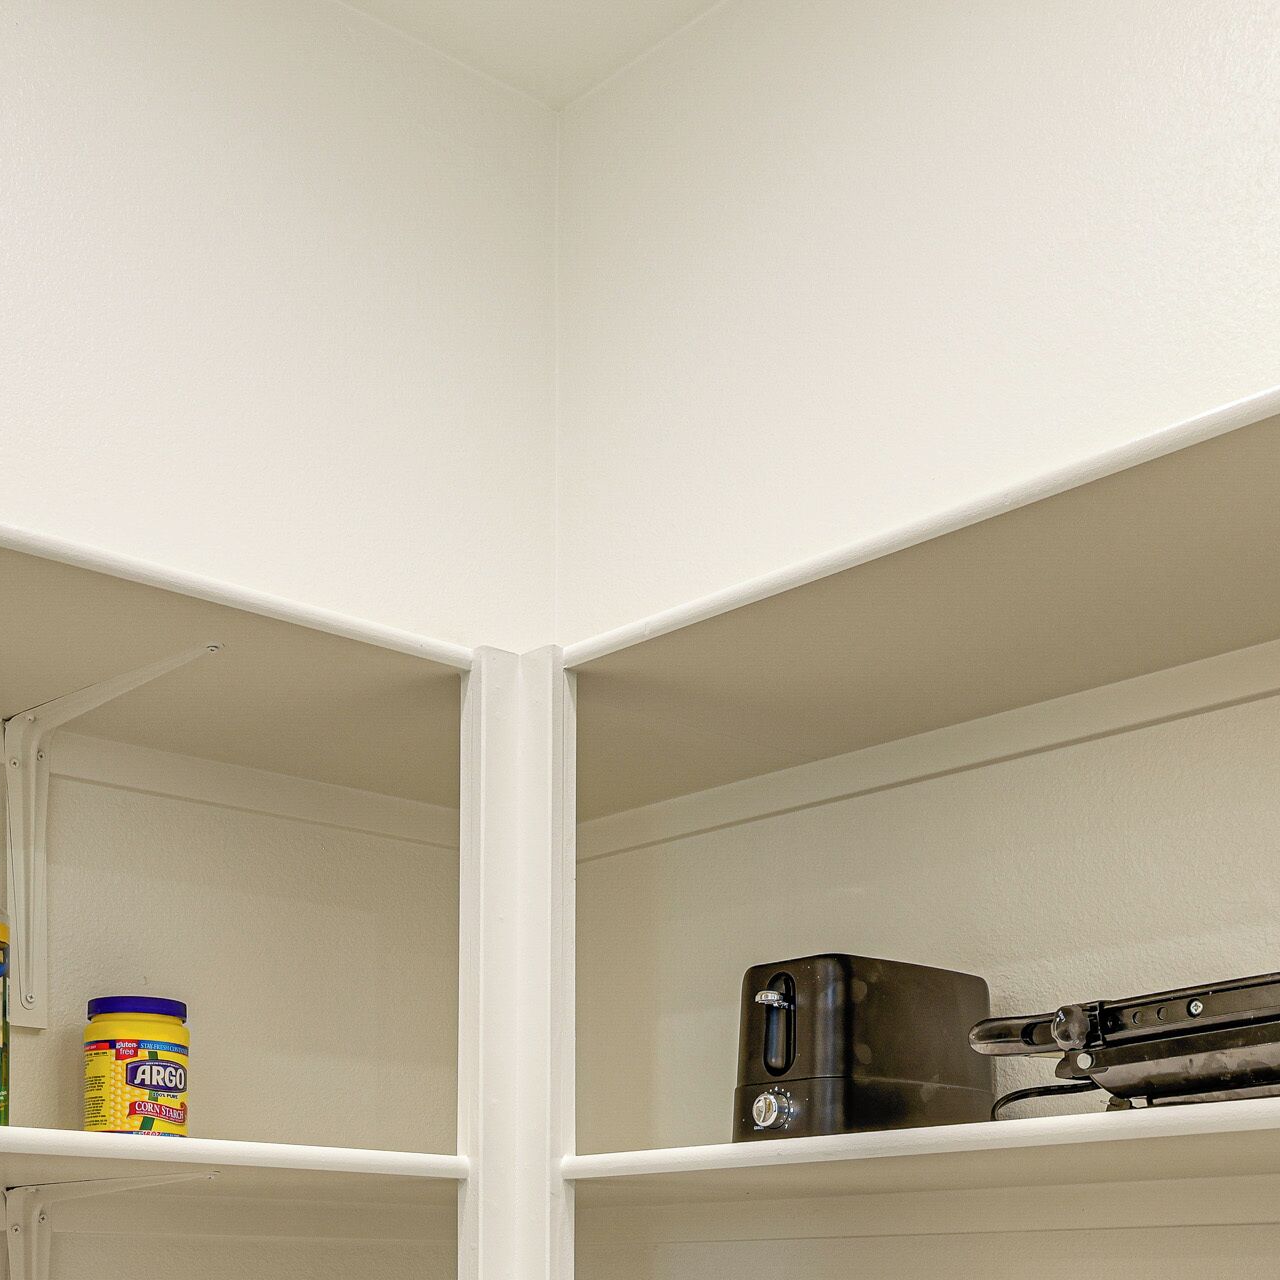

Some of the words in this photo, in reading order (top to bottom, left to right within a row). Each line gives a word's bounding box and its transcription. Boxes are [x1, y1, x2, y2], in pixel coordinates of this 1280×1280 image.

[116, 1041, 138, 1049] gluten-
[119, 1048, 134, 1056] free
[134, 1065, 185, 1089] ARGO
[135, 1101, 160, 1114] CORN
[161, 1106, 184, 1120] STARCH
